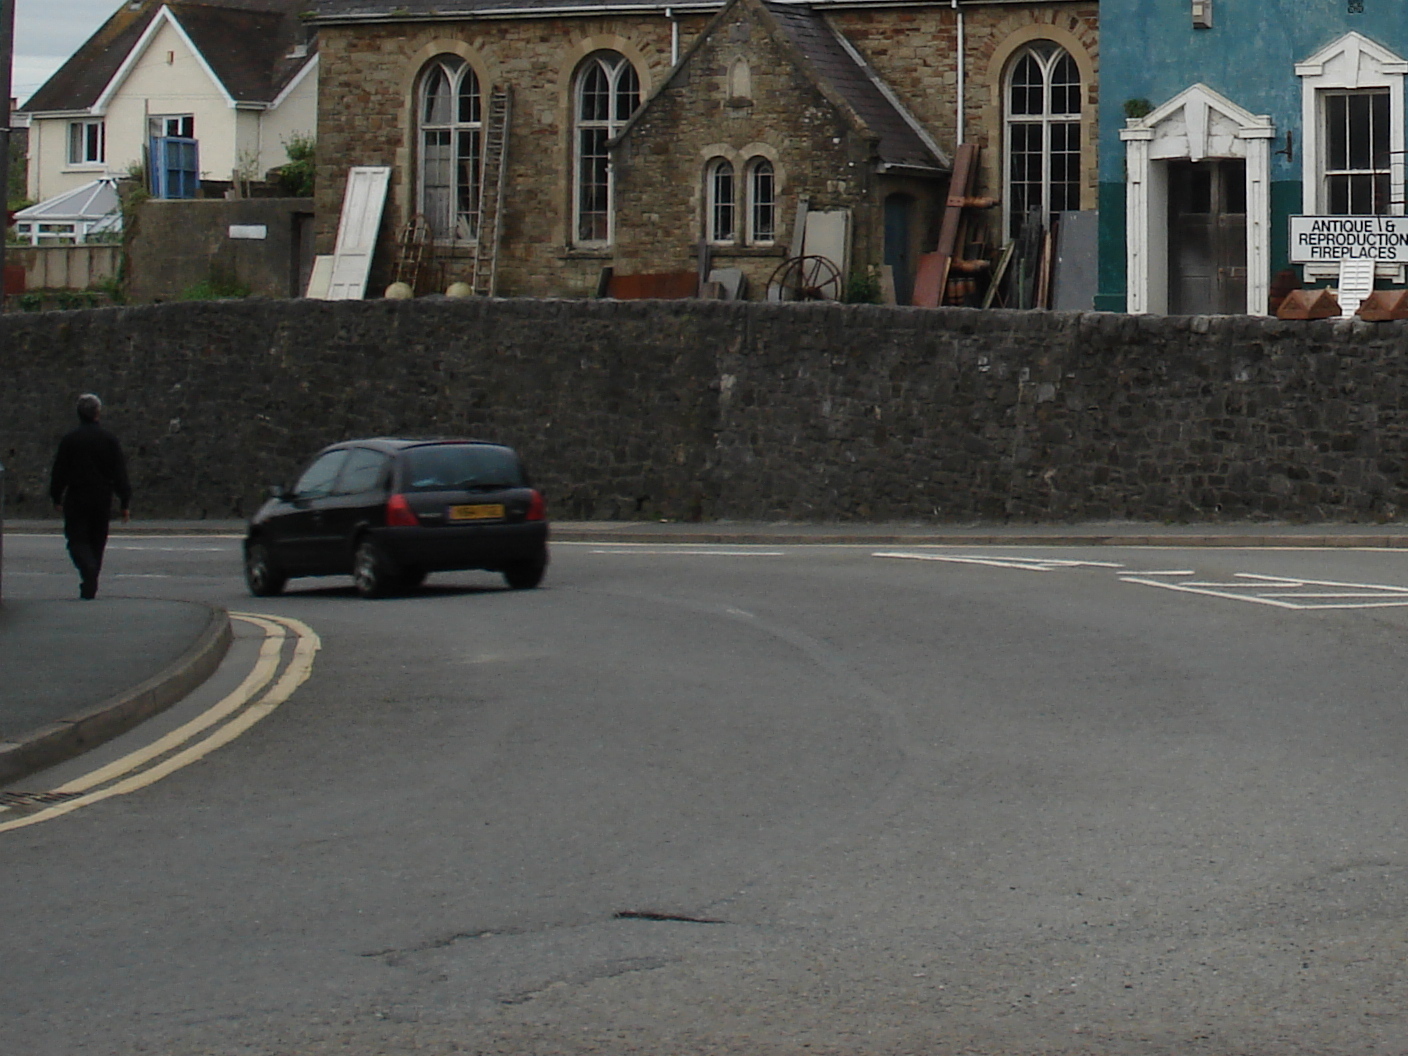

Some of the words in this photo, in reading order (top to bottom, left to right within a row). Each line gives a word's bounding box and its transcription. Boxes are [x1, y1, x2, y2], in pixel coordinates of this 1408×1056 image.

[1312, 220, 1372, 232] ANTIQUE
[1386, 220, 1396, 232] &
[1299, 233, 1408, 246] REPRODUCTION
[1311, 246, 1396, 259] FIREPLACES
